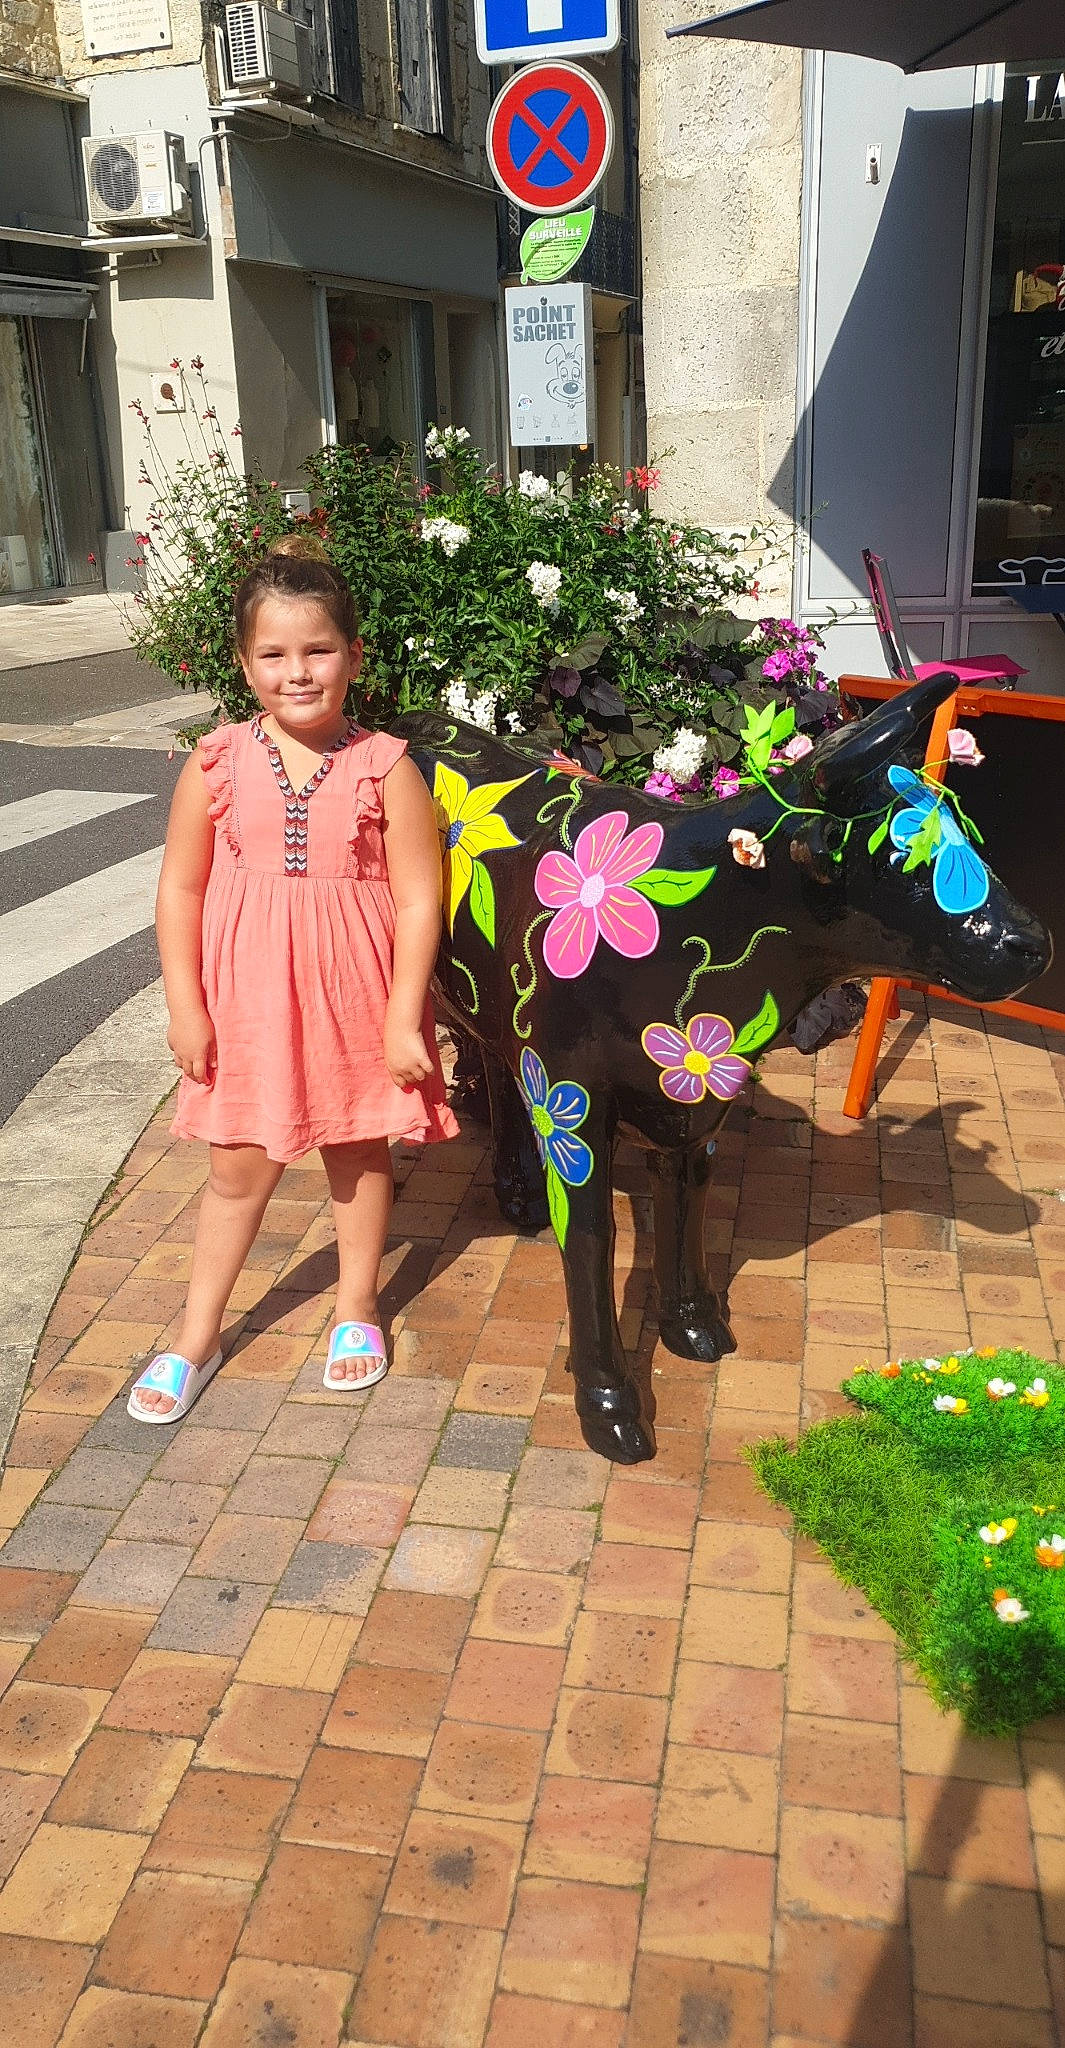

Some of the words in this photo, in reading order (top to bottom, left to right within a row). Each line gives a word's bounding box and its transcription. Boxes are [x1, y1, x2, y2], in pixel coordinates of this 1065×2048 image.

[530, 225, 582, 240] SURVEILLÉ
[544, 218, 566, 229] LIEU
[512, 303, 576, 325] POINT
[513, 322, 577, 343] SACHET
